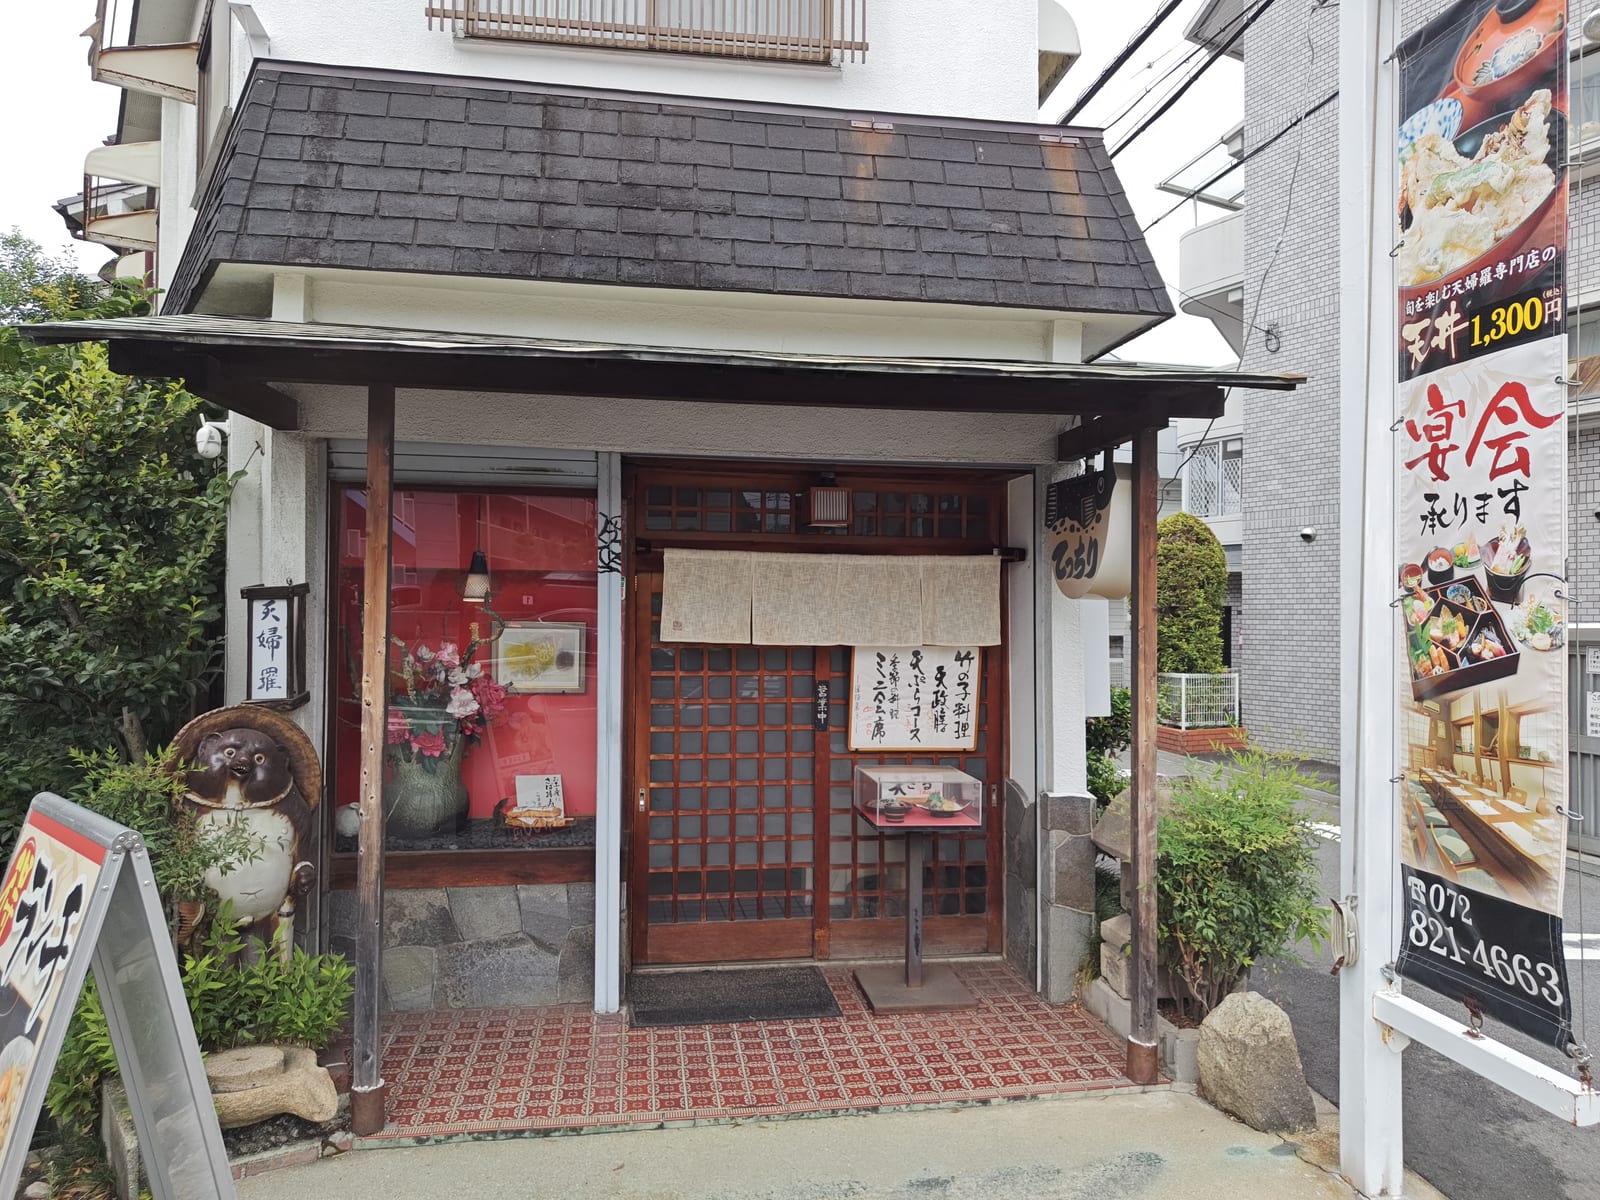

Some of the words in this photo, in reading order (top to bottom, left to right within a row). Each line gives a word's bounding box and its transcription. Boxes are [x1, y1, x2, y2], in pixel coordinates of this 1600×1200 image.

[1405, 246, 1556, 316] 旬を楽しむ天婦羅専門店の
[1404, 381, 1565, 482] 宴会
[1420, 479, 1529, 536] 承ります
[256, 599, 283, 693] 天婦羅
[817, 684, 828, 725] 営業中
[908, 649, 927, 743] 天ぷらコース
[953, 650, 975, 740] 竹の子料理
[1429, 883, 1473, 926] 072
[1409, 909, 1565, 1007] 821-4663
